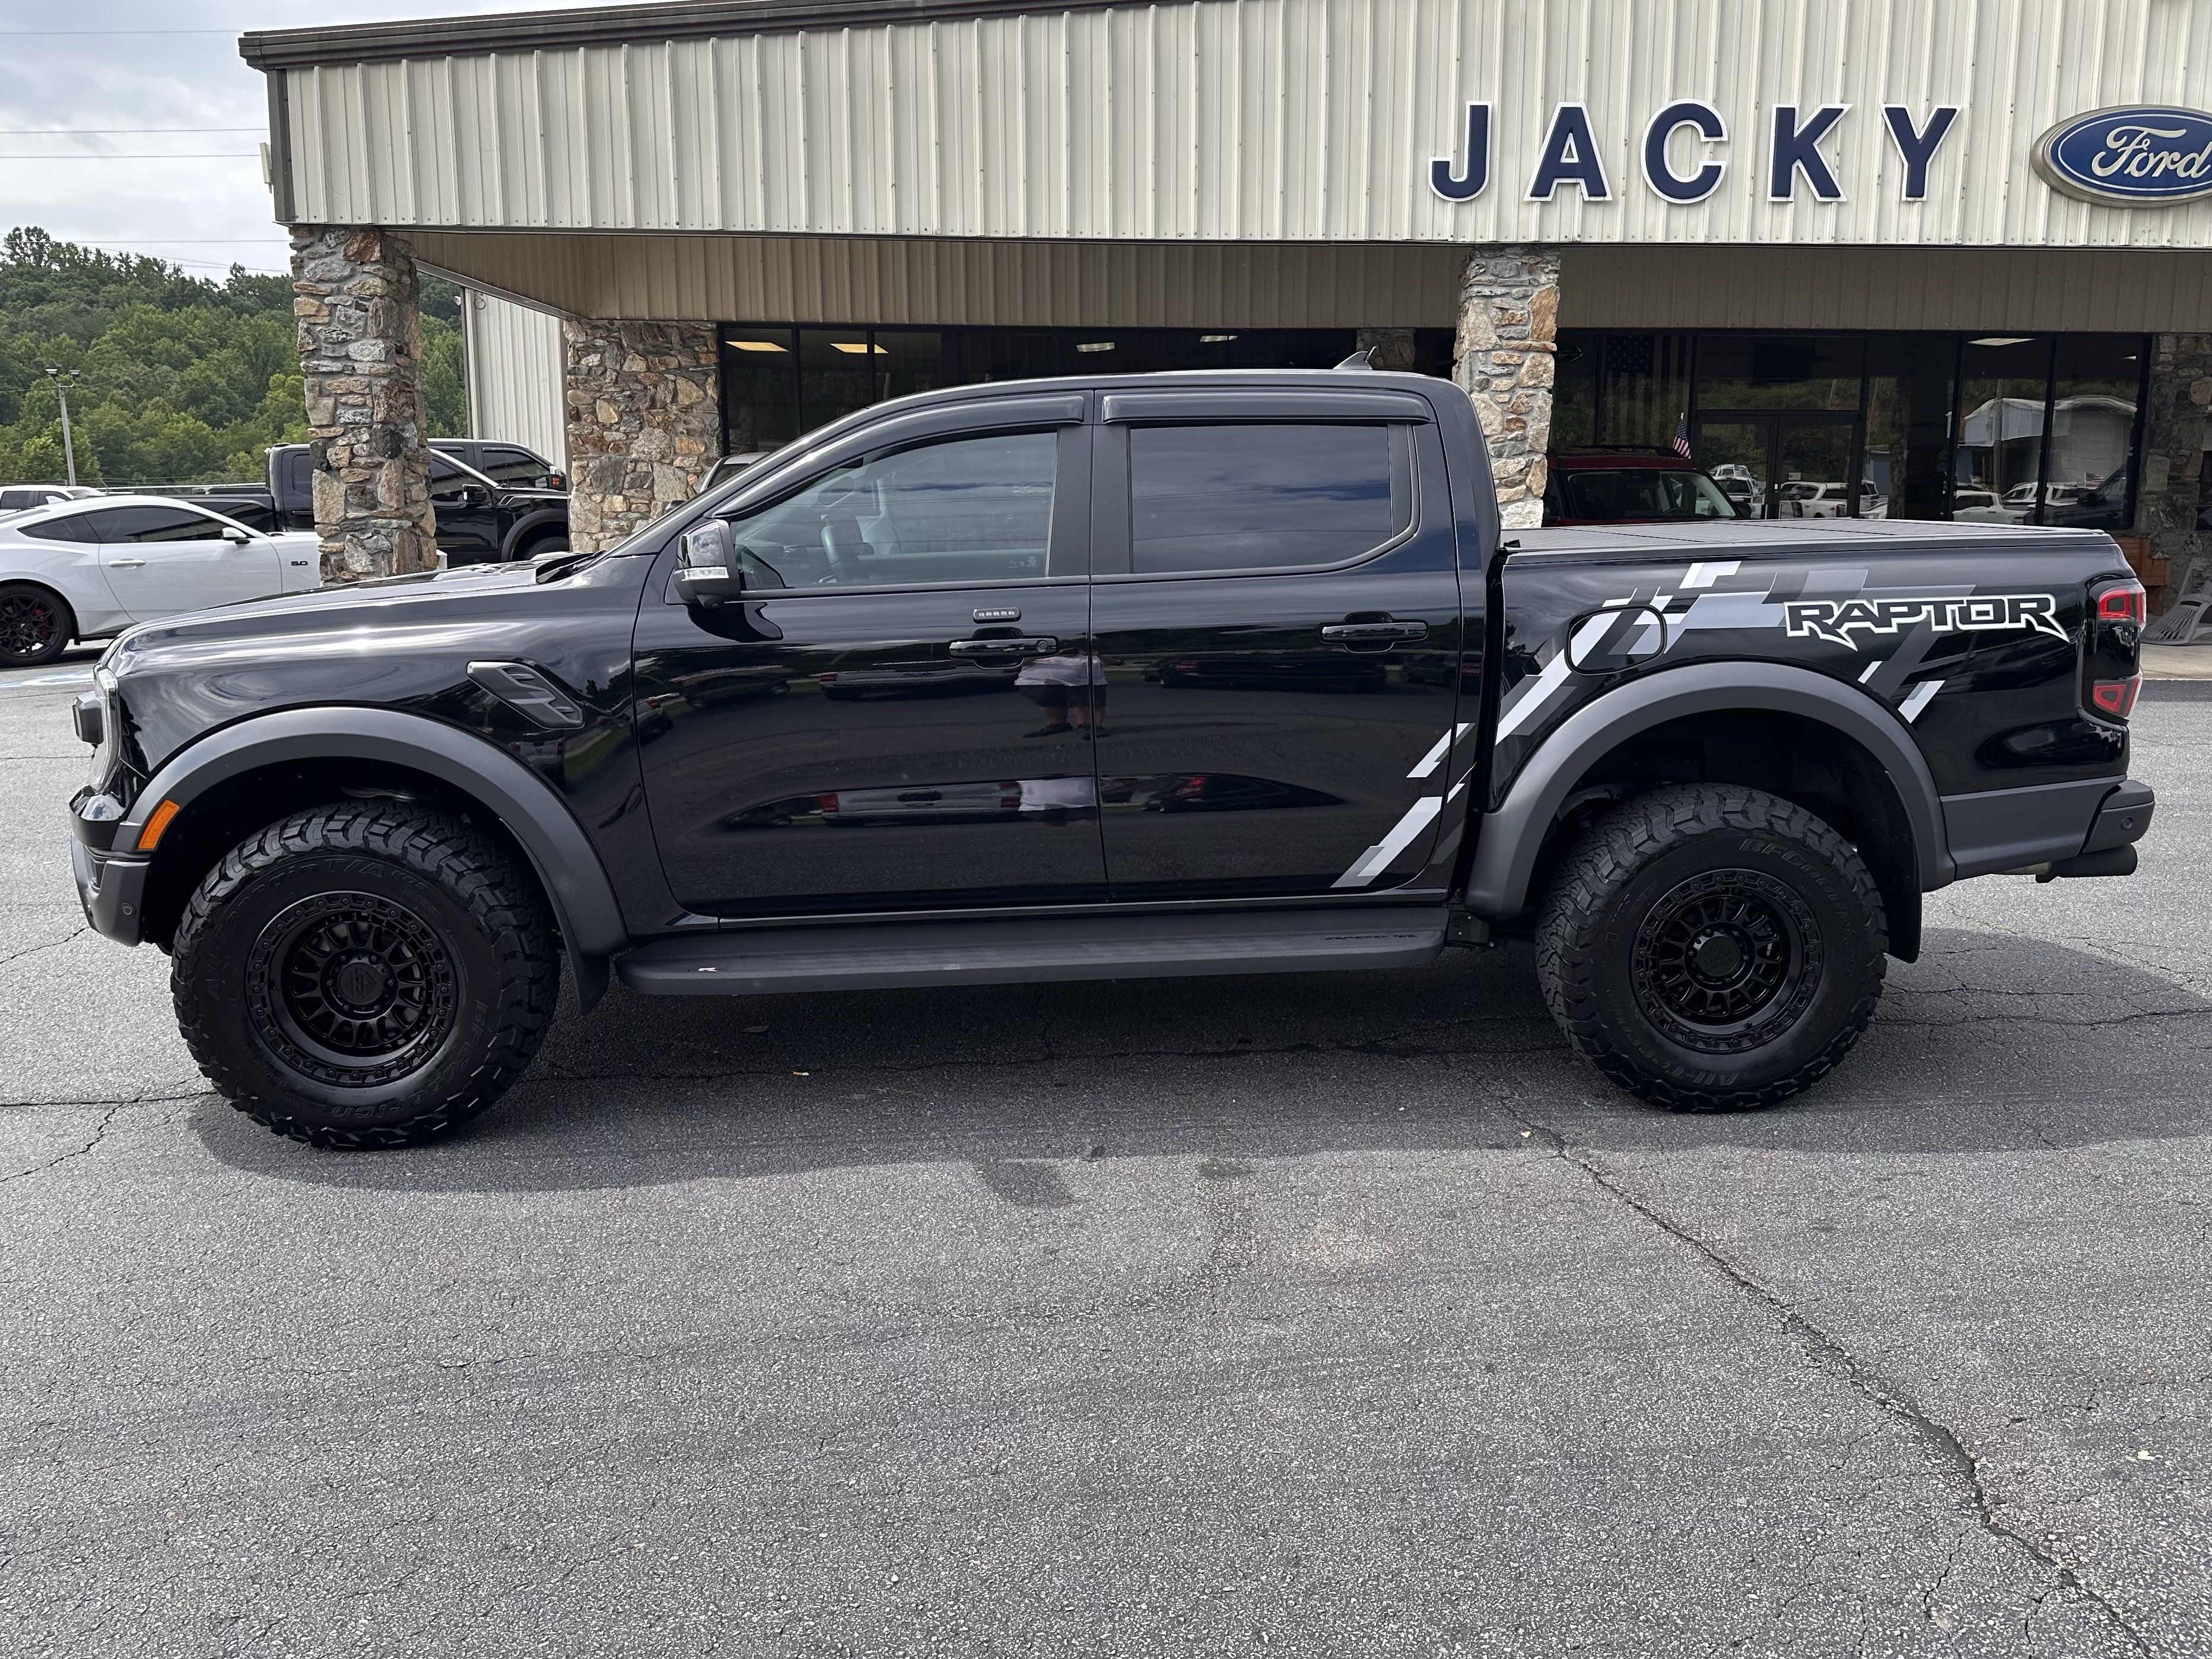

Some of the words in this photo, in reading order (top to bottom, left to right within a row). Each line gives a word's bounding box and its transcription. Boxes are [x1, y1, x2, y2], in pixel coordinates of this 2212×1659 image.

[1428, 98, 1962, 204] JACKY
[2092, 125, 2212, 179] Ford
[1783, 593, 2070, 652] RAPTOR
